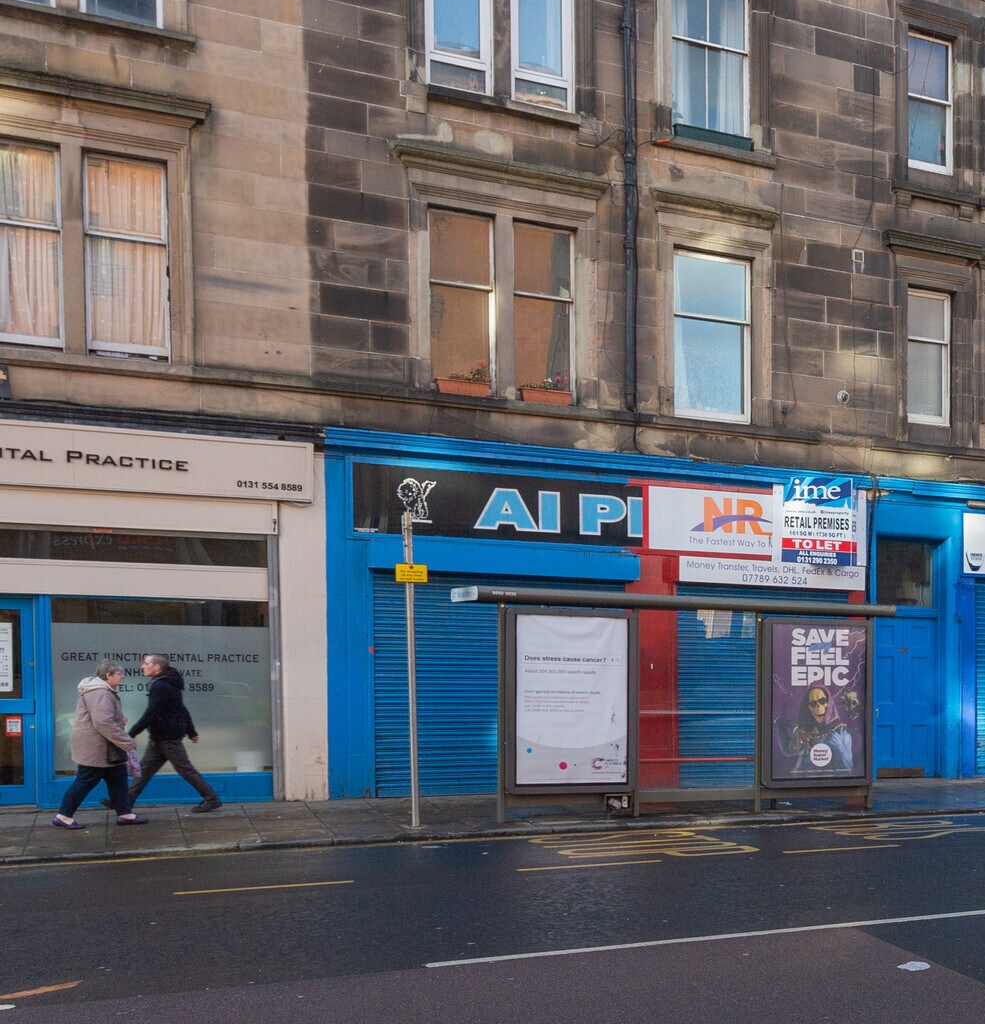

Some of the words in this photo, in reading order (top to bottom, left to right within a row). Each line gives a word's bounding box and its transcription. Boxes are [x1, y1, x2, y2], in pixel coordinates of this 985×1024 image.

[66, 450, 189, 472] PRACTICE
[236, 479, 259, 489] 0131
[262, 481, 279, 491] 554
[281, 482, 303, 492] 8589
[793, 479, 841, 500] ime
[703, 496, 773, 536] NR
[784, 516, 811, 528] RETAIL
[813, 517, 850, 530] PREMISES
[689, 536, 703, 544] The
[706, 537, 735, 546] Fastest
[737, 539, 755, 548] Way
[792, 538, 813, 549] TO
[816, 540, 842, 551] LET
[686, 561, 715, 573] Money
[718, 563, 749, 573] Transfer,
[752, 565, 780, 574] Travels,
[802, 567, 824, 576] FedEx
[834, 570, 859, 579] Cargo
[742, 574, 770, 584] 07789
[773, 575, 788, 585] 632
[791, 576, 808, 585] 524
[791, 628, 850, 646] SAVE
[61, 652, 98, 662] GREAT
[104, 652, 149, 661] JUNCTI
[207, 653, 259, 663] PRACTICE
[791, 646, 850, 666] FEEL
[791, 666, 850, 687] EPIC
[118, 684, 134, 692] EL:
[189, 683, 214, 692] 8589
